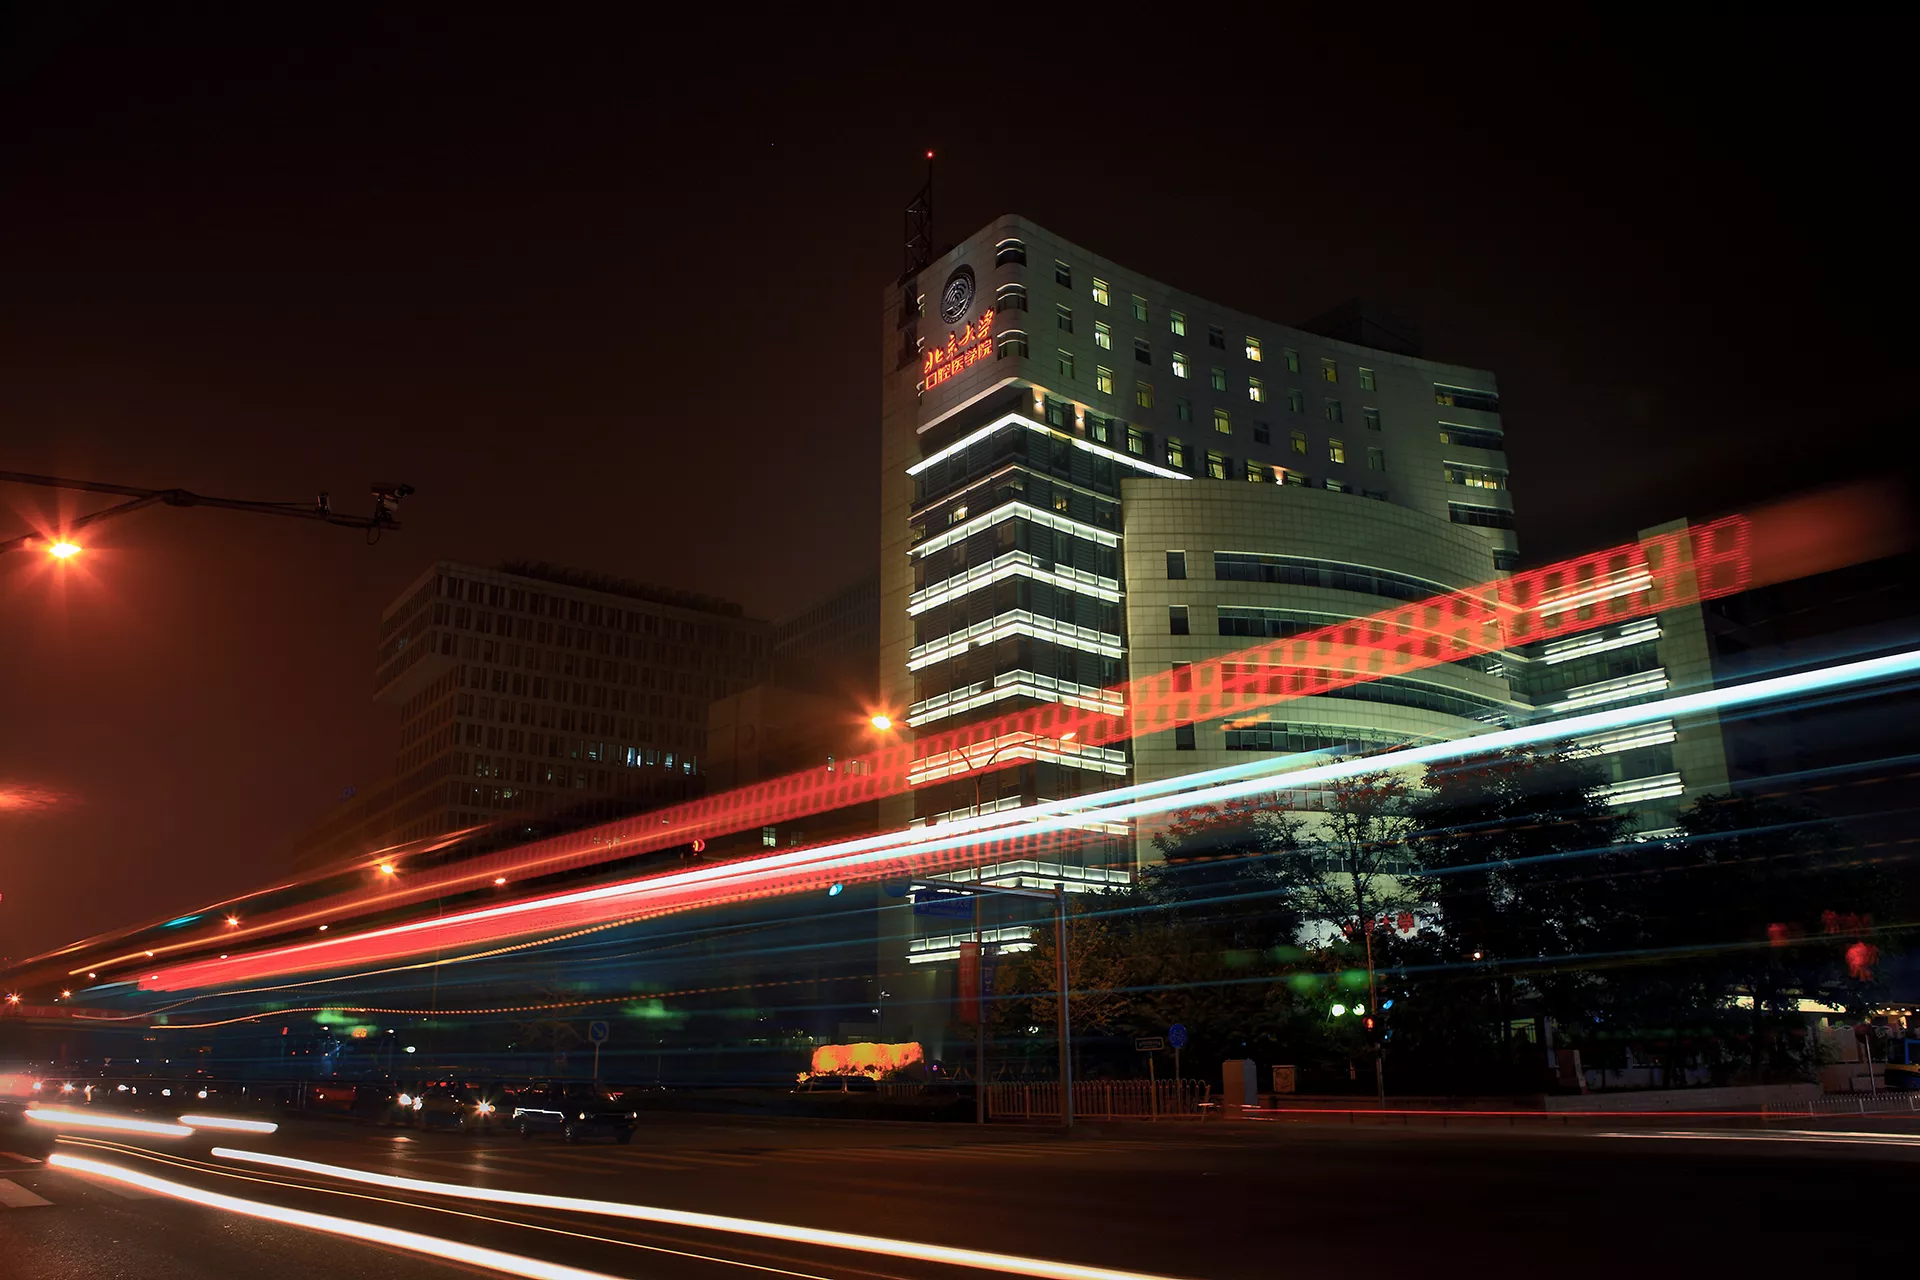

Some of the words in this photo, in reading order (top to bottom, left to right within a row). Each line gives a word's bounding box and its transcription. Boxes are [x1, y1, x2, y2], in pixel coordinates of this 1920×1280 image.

[925, 338, 993, 391] 口腔医学院
